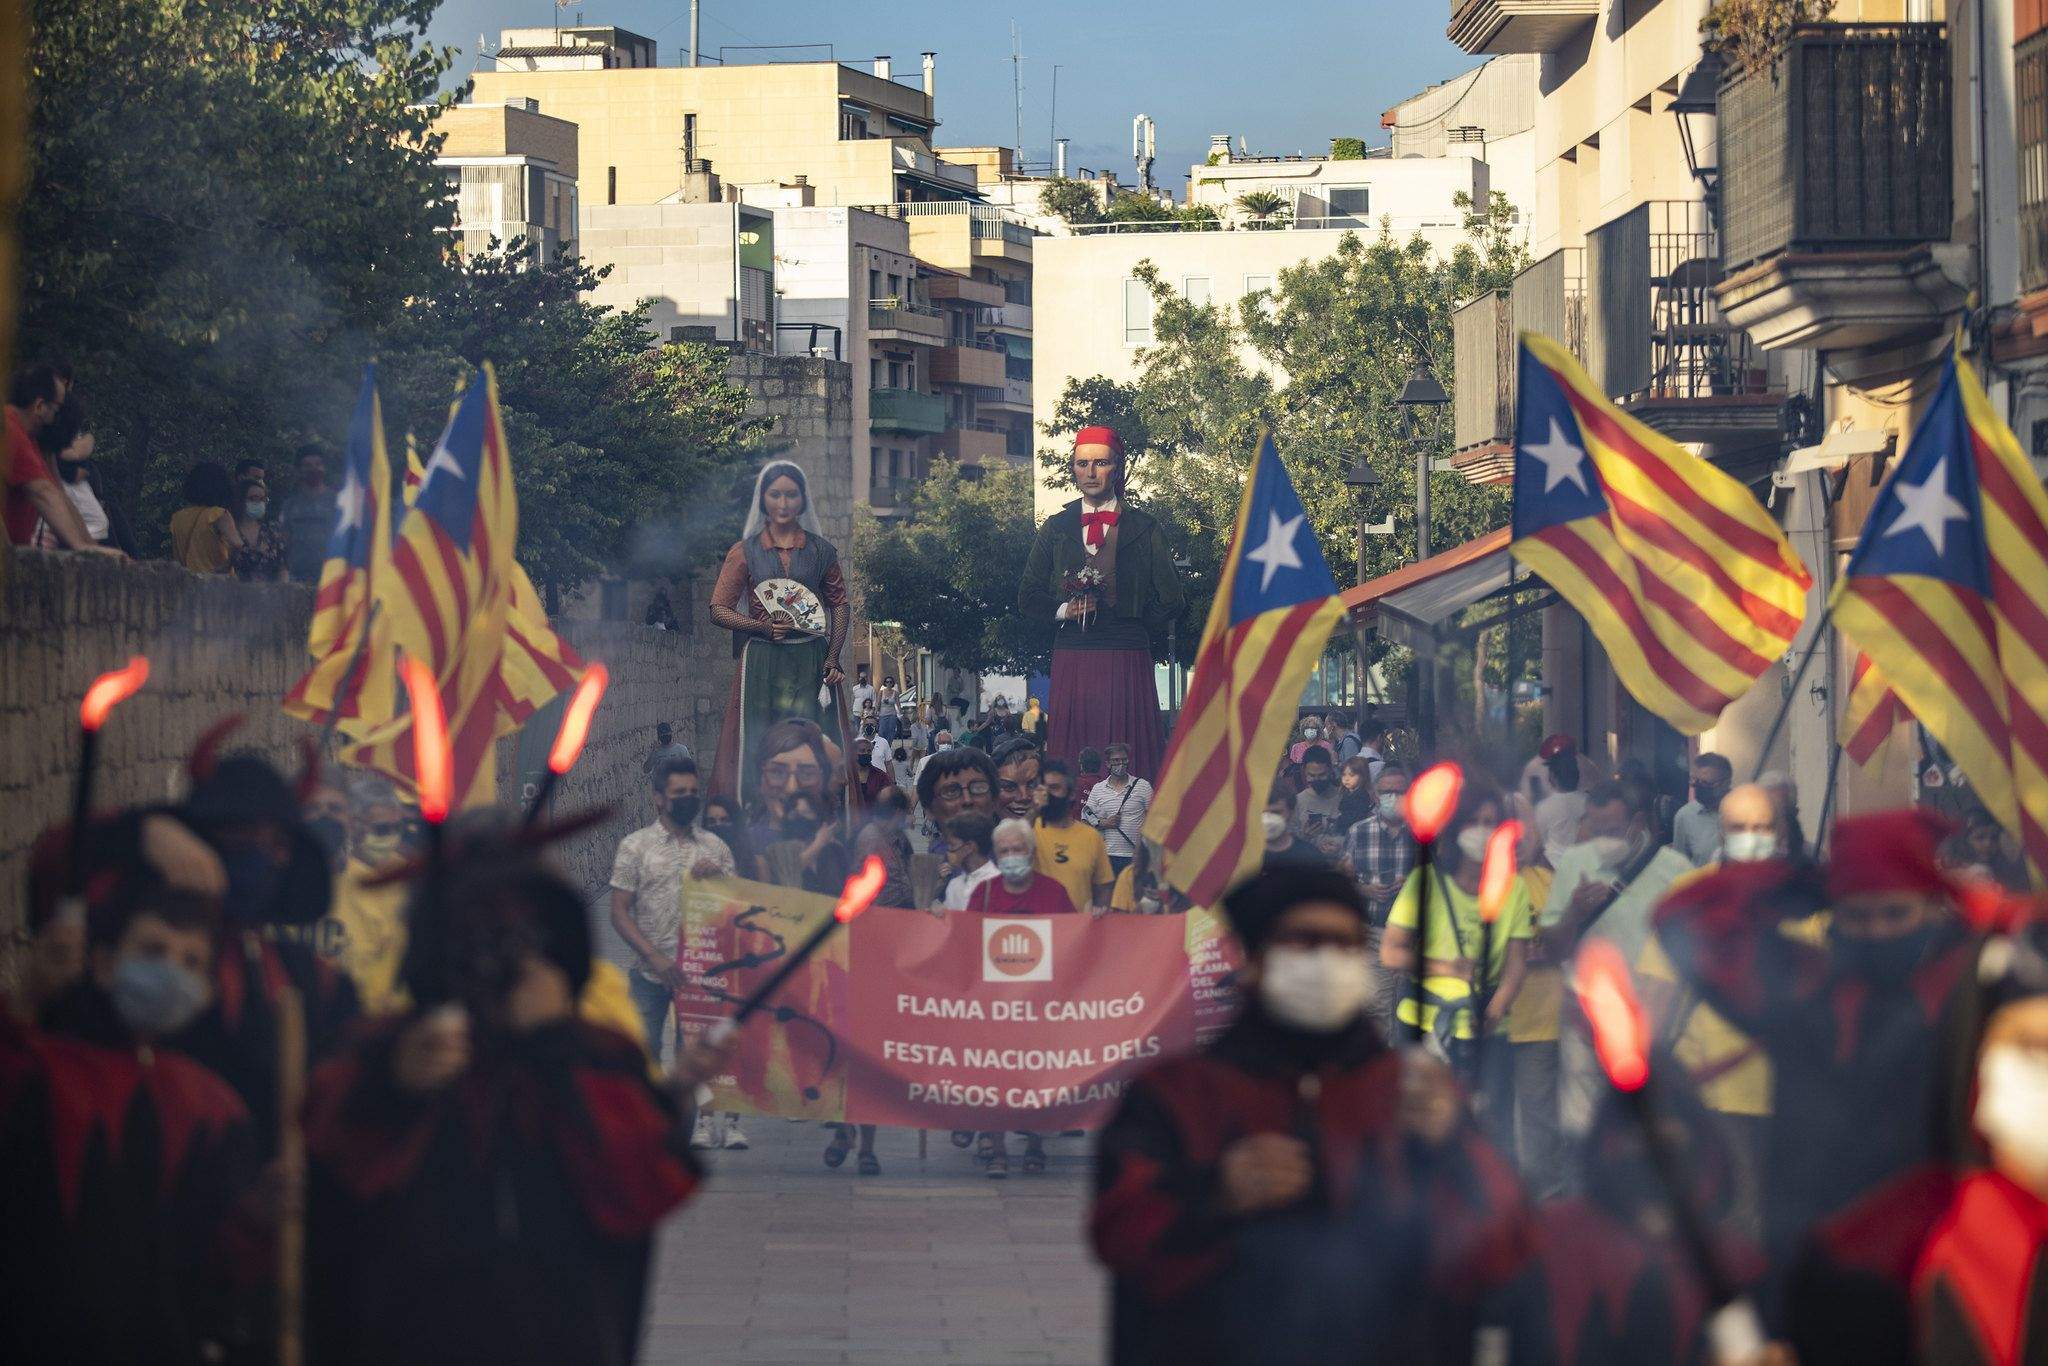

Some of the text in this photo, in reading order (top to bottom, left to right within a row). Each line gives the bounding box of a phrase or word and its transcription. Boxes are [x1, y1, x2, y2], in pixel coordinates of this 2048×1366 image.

[684, 949, 724, 963] FLAMA
[683, 962, 705, 973] DEL
[1189, 962, 1231, 976] FLAMA
[1190, 977, 1216, 988] DEL
[897, 991, 1145, 1021] FLAMA DEL CANIGÓ
[883, 1036, 1160, 1070] FESTA NACIONAL DELS
[908, 1079, 999, 1107] PAÏSOS
